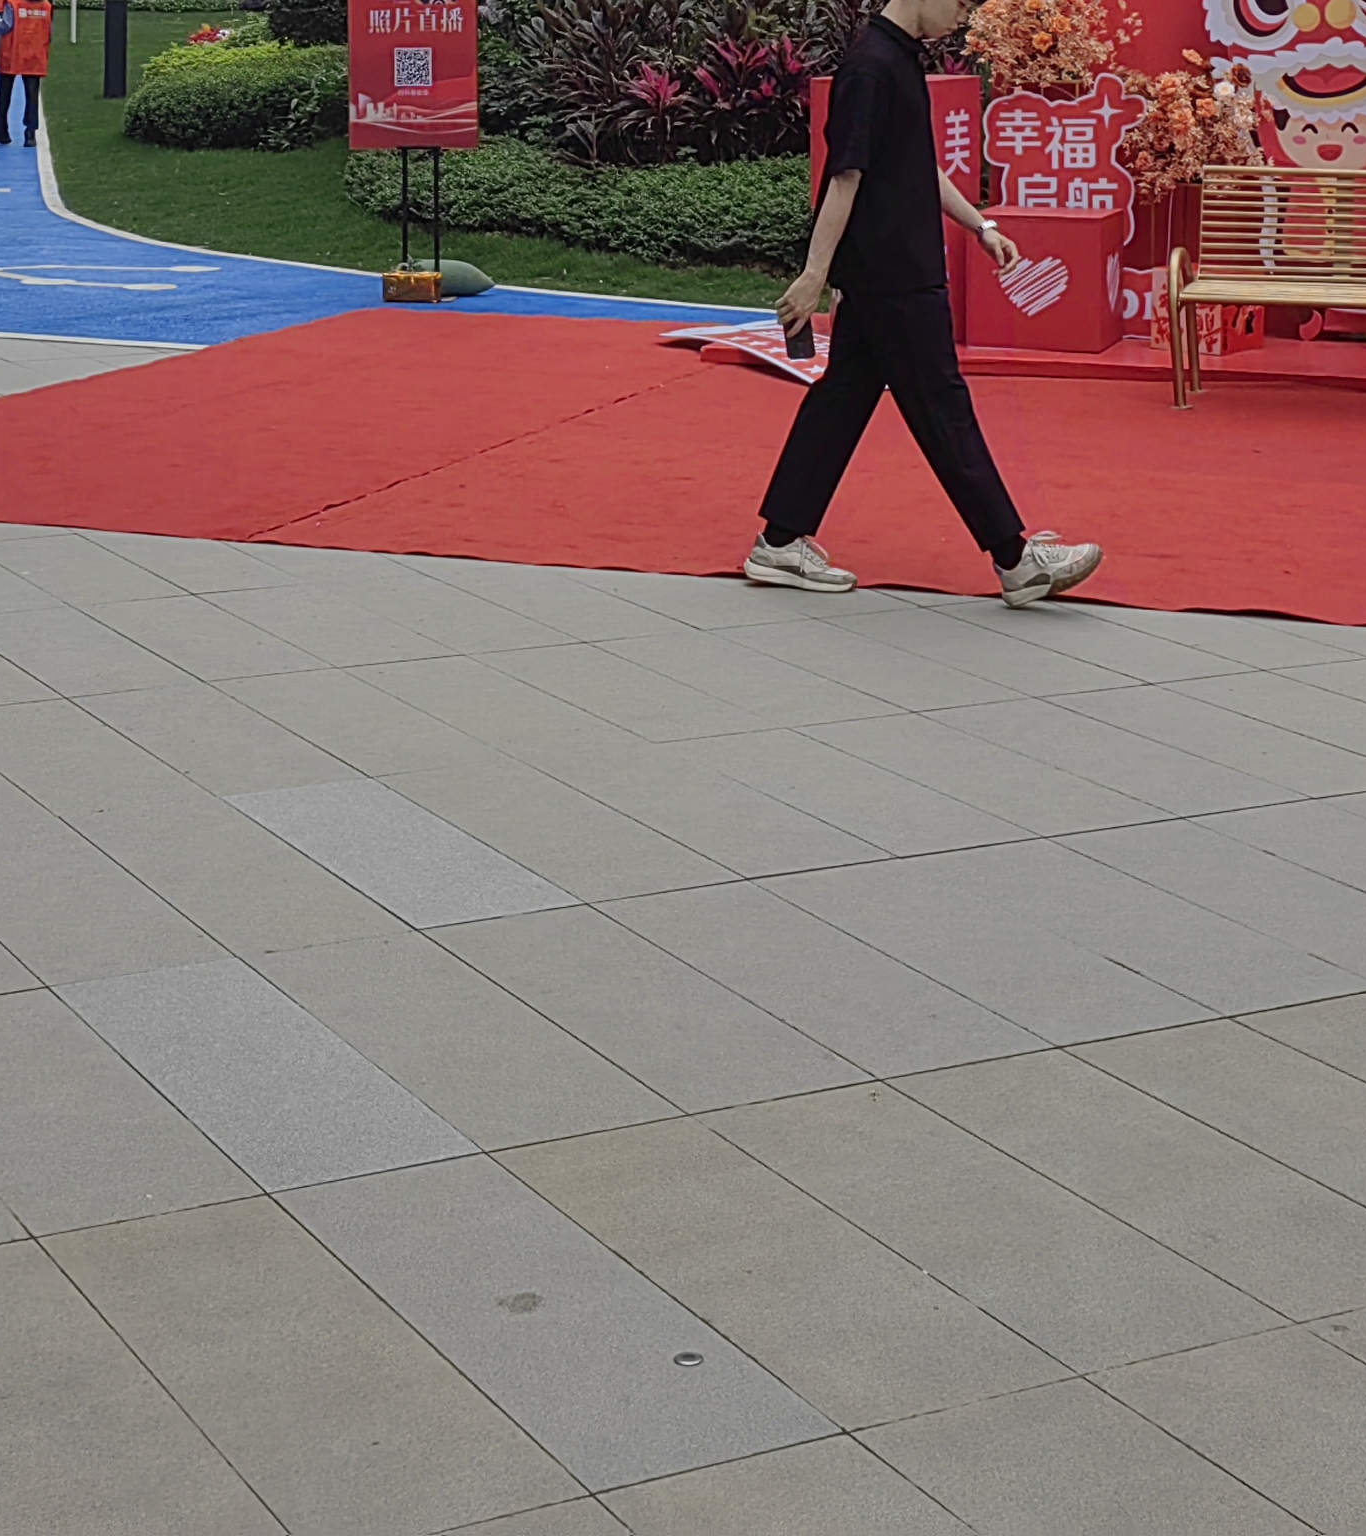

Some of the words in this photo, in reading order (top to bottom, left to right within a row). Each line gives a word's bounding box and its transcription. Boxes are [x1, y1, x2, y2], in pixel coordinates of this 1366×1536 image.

[368, 7, 463, 34] 照片直播
[996, 108, 1098, 170] 幸福
